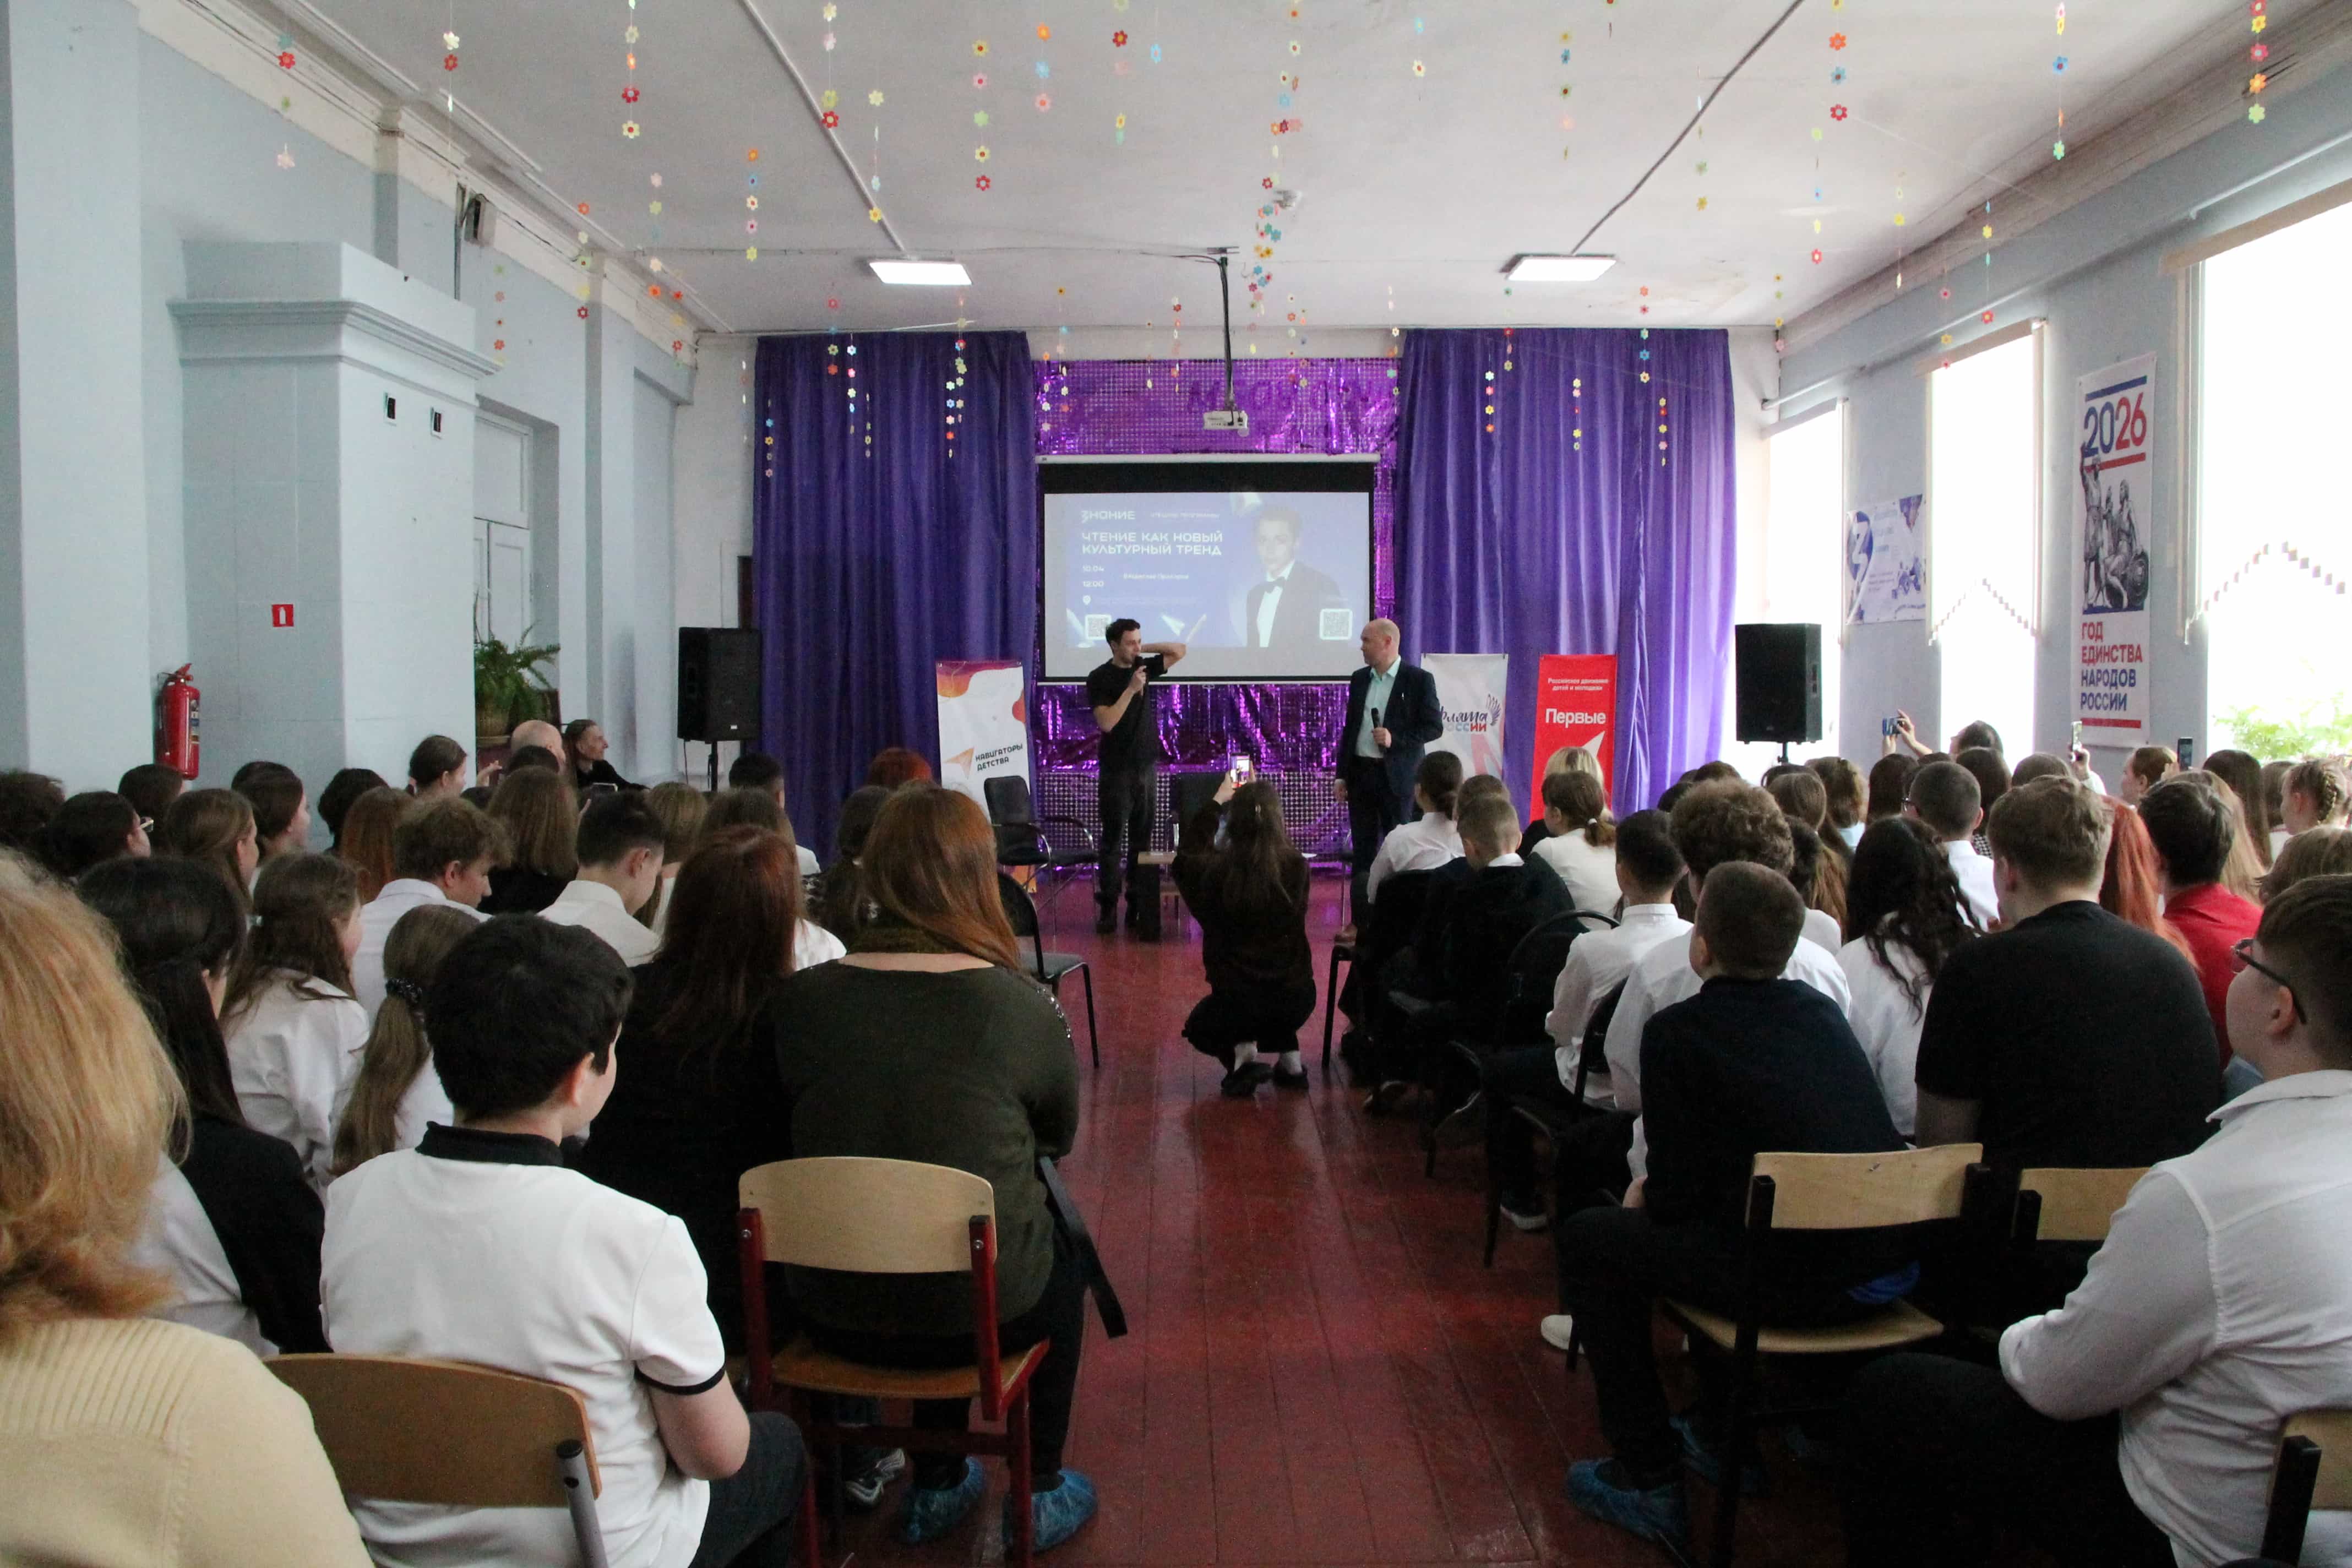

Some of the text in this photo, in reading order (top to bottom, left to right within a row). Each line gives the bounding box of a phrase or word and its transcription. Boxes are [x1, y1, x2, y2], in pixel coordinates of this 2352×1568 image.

[2083, 392, 2147, 458] 2026
[1082, 530, 1223, 542] ЧТЕНИЕ КАК НОВЫЙ
[1082, 542, 1222, 556] КУЛЬТУРНЫЙ ТРЕНД
[2082, 622, 2103, 641] ГОД
[2081, 644, 2143, 666] ЕДИНСТВА
[2081, 668, 2136, 690] НАРОДОВ
[2081, 692, 2127, 711] РОССИИ
[1545, 708, 1607, 728] Первые
[977, 756, 1009, 771] ДЕТСТВА
